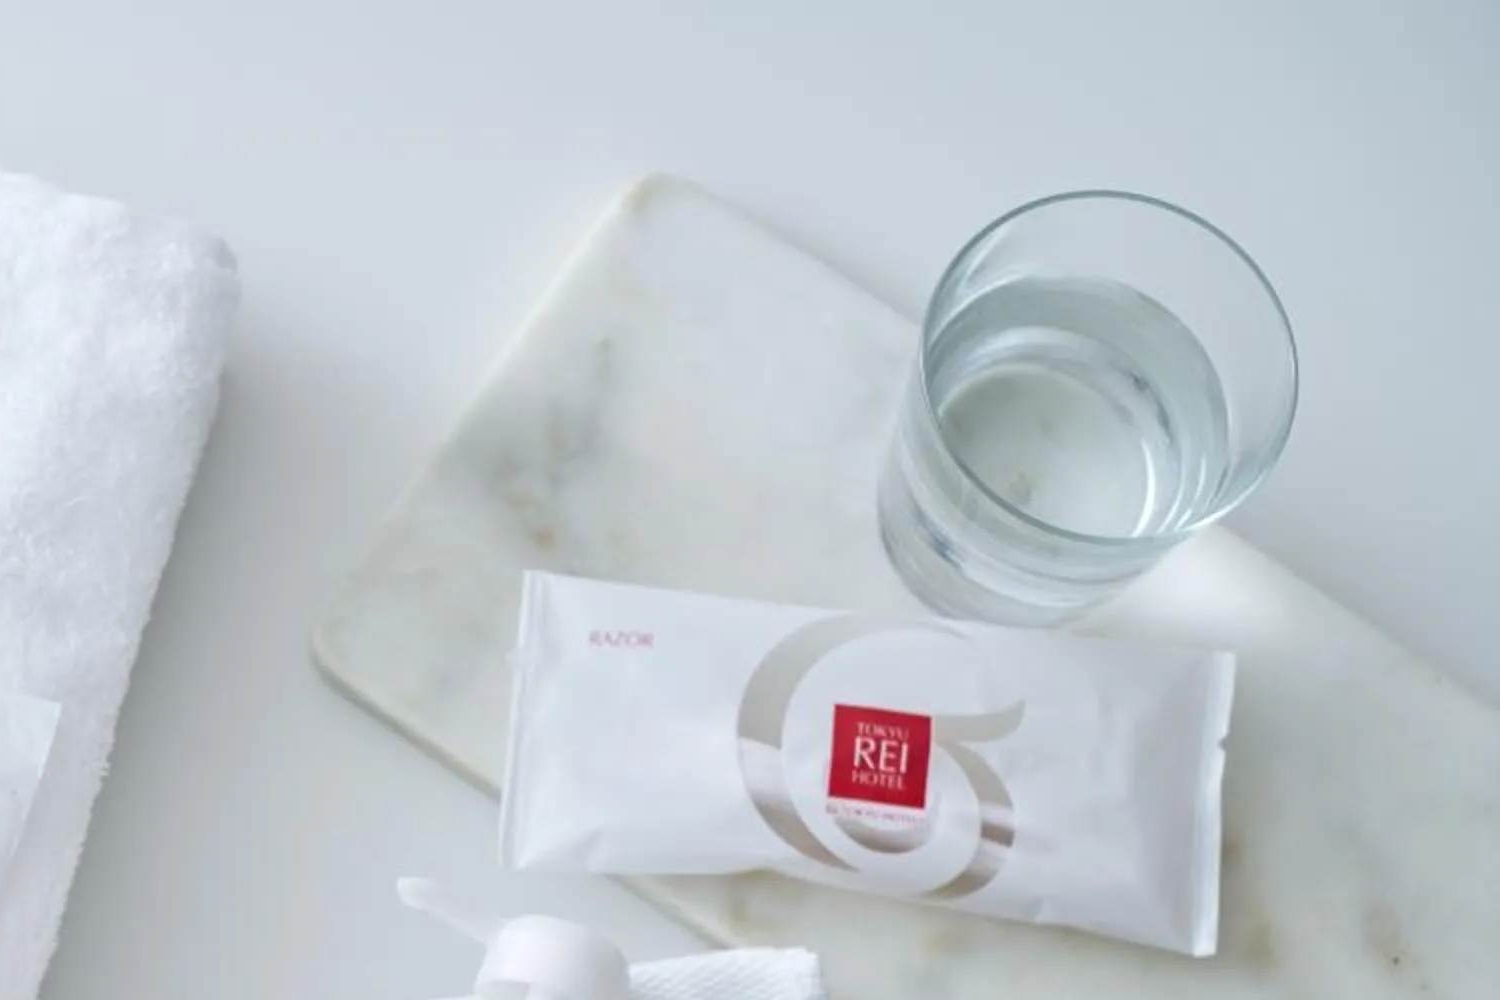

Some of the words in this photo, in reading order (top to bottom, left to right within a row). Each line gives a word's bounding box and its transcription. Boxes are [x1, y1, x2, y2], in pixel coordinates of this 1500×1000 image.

[589, 629, 655, 650] RAZOR
[856, 722, 911, 742] TOKYU
[853, 735, 909, 775] REI
[851, 769, 908, 791] HOTEL
